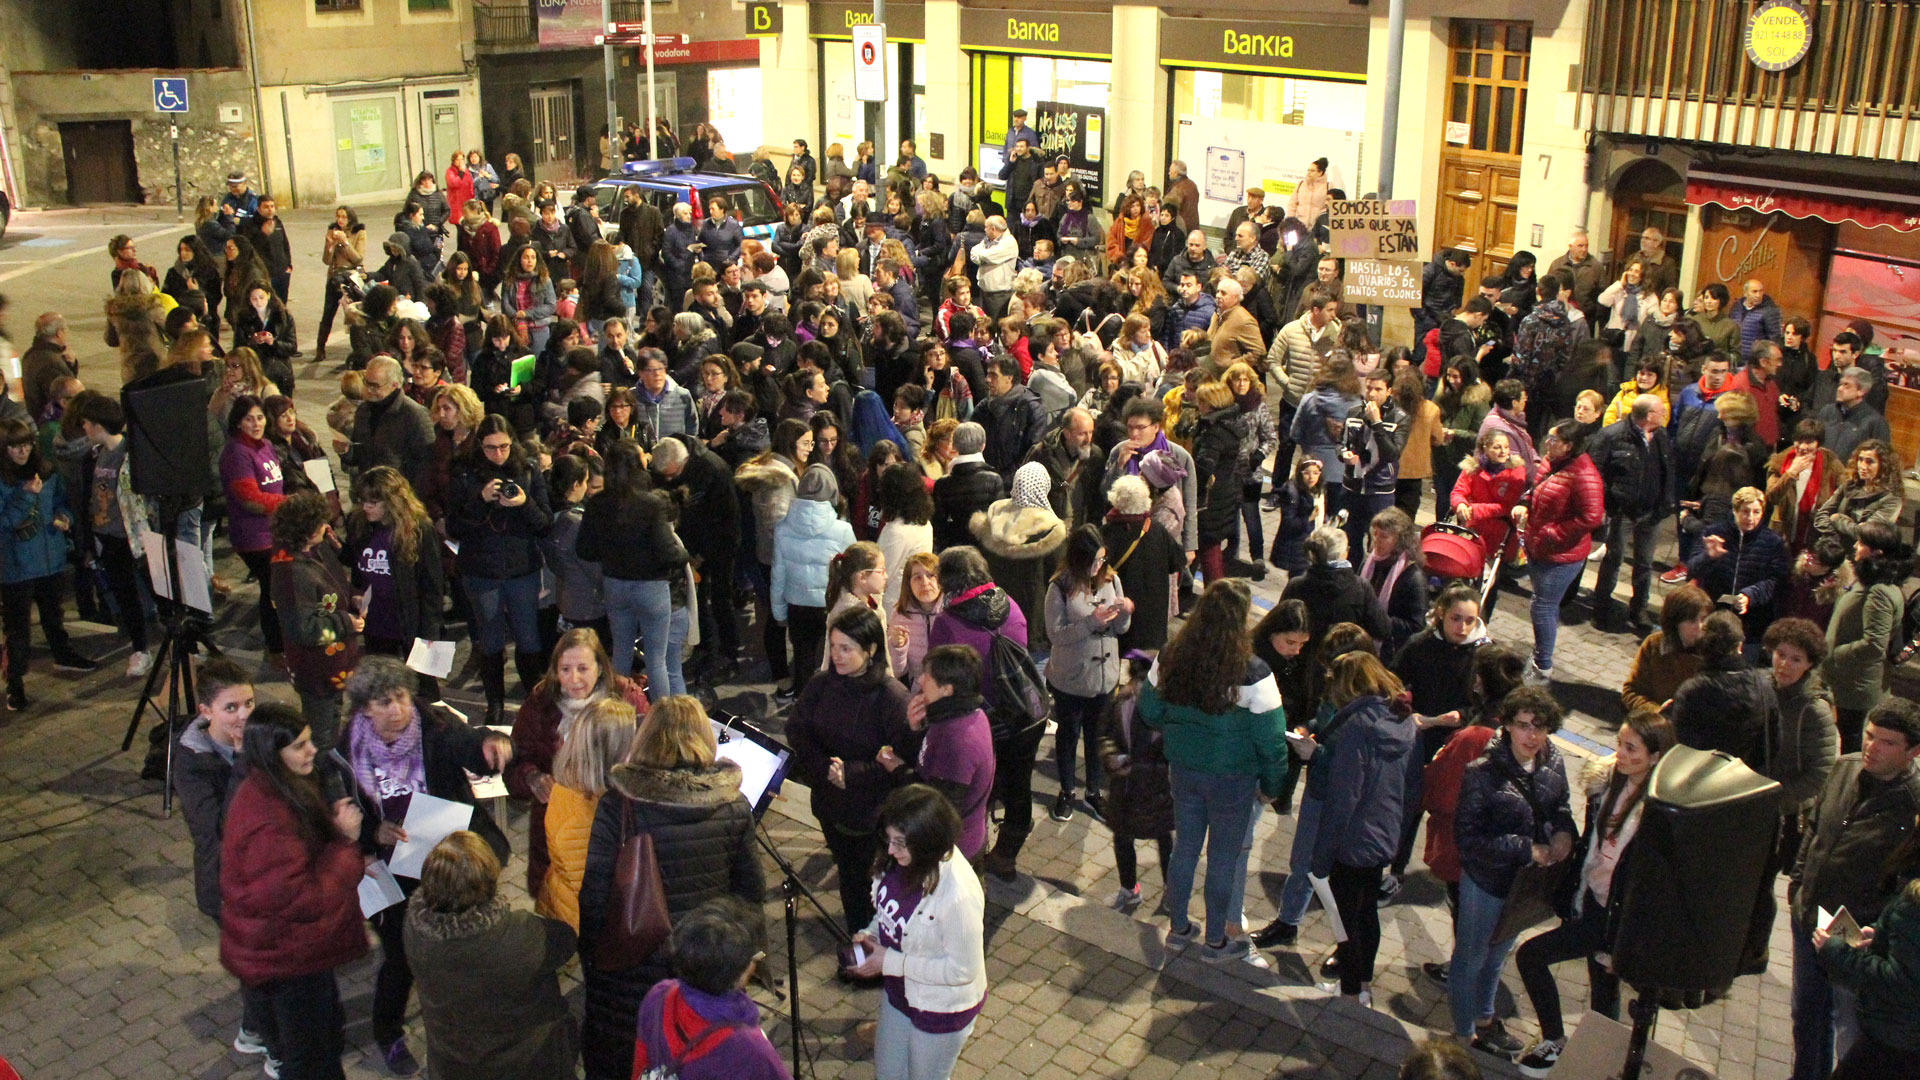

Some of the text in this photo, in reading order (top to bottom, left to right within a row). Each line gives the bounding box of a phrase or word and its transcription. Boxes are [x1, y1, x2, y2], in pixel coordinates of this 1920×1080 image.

[754, 6, 772, 30] B
[1763, 16, 1798, 25] VENDE
[1007, 18, 1060, 42] Bankia
[1755, 31, 1768, 39] 921
[1223, 29, 1293, 58] Bankia
[655, 49, 690, 58] vodafone
[1766, 47, 1787, 56] SOL
[1538, 154, 1552, 180] 7
[1332, 201, 1370, 216] SOMOS
[1373, 202, 1389, 215] EL
[1331, 219, 1415, 233] DE LAS QUE YA
[1350, 262, 1410, 278] HASTA LOS
[1402, 278, 1416, 288] DE
[1346, 285, 1421, 300] TANTOS COJONES
